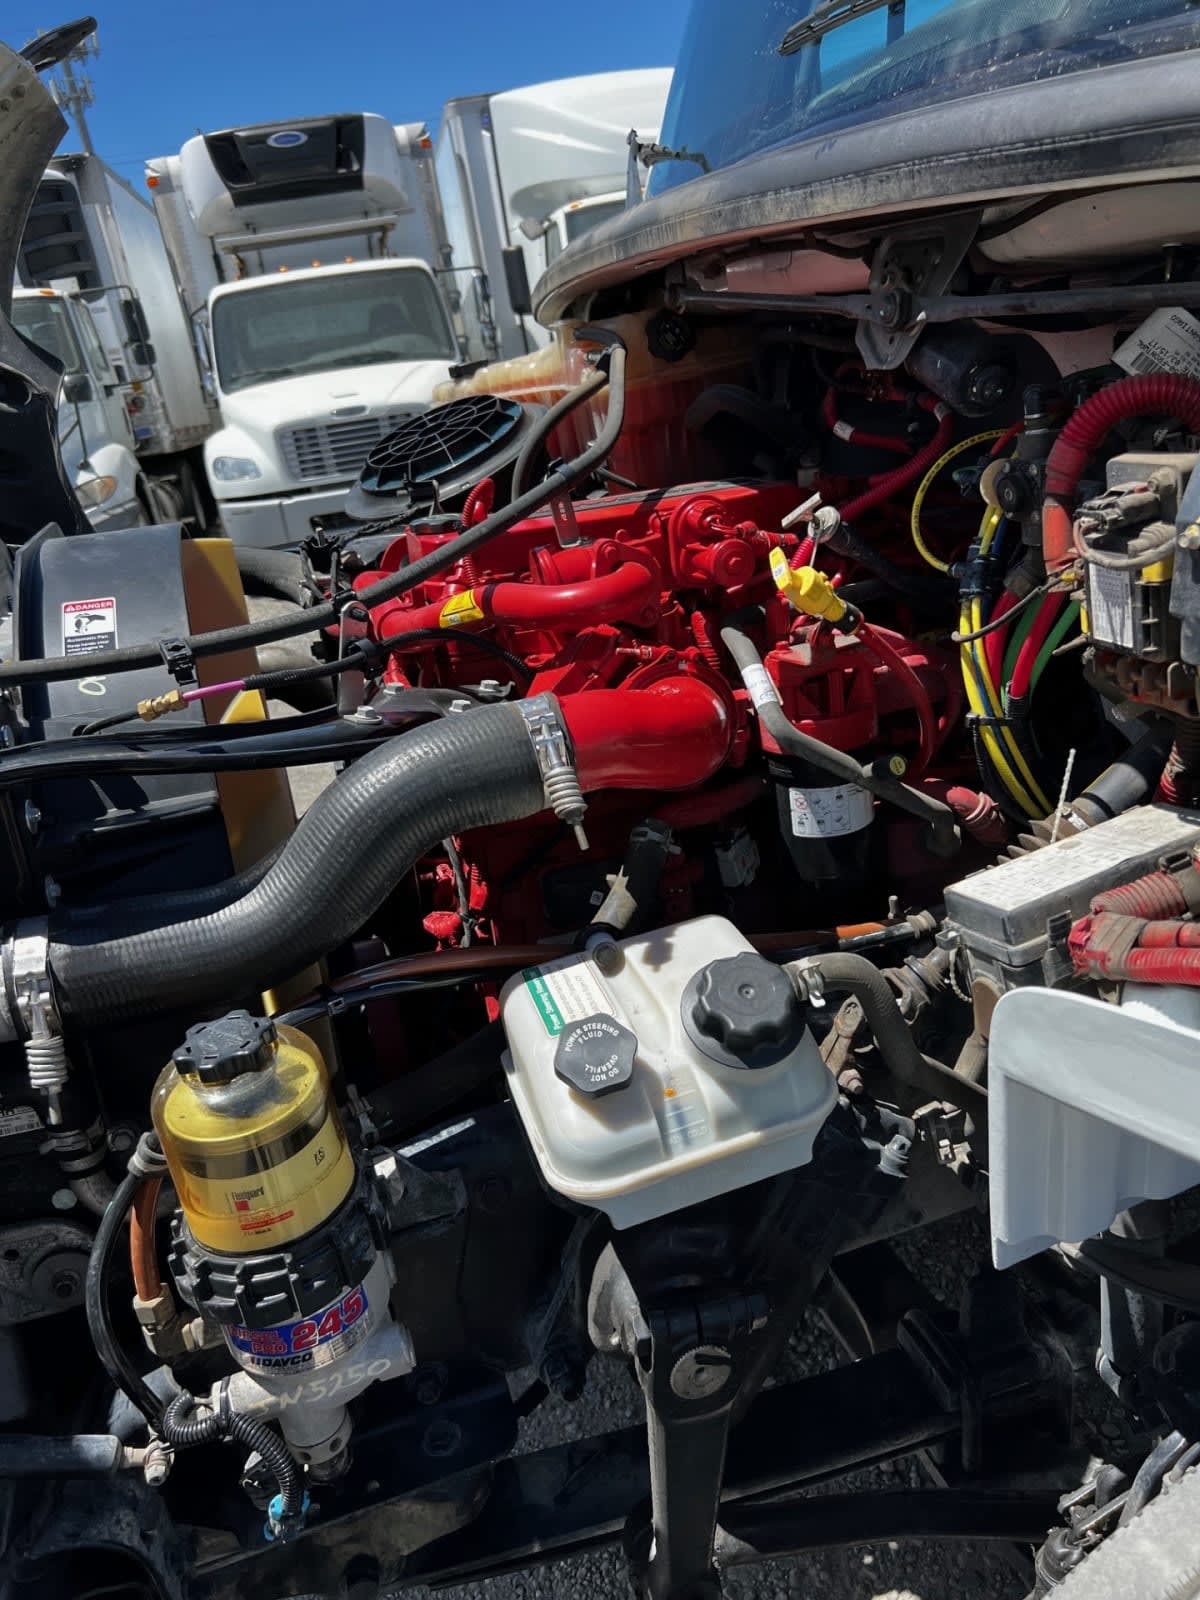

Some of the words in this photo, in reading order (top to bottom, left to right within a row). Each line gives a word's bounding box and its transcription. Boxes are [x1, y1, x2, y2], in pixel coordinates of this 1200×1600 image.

[75, 601, 112, 610] DANGER
[565, 1028, 583, 1052] POWER
[582, 1022, 619, 1037] STEERING
[577, 1030, 603, 1045] FLUID
[584, 1054, 618, 1074] OVERFILL
[590, 1073, 607, 1082] NOT
[608, 1067, 620, 1078] DO
[291, 1285, 364, 1353] 245
[261, 1352, 313, 1368] DAYCO
